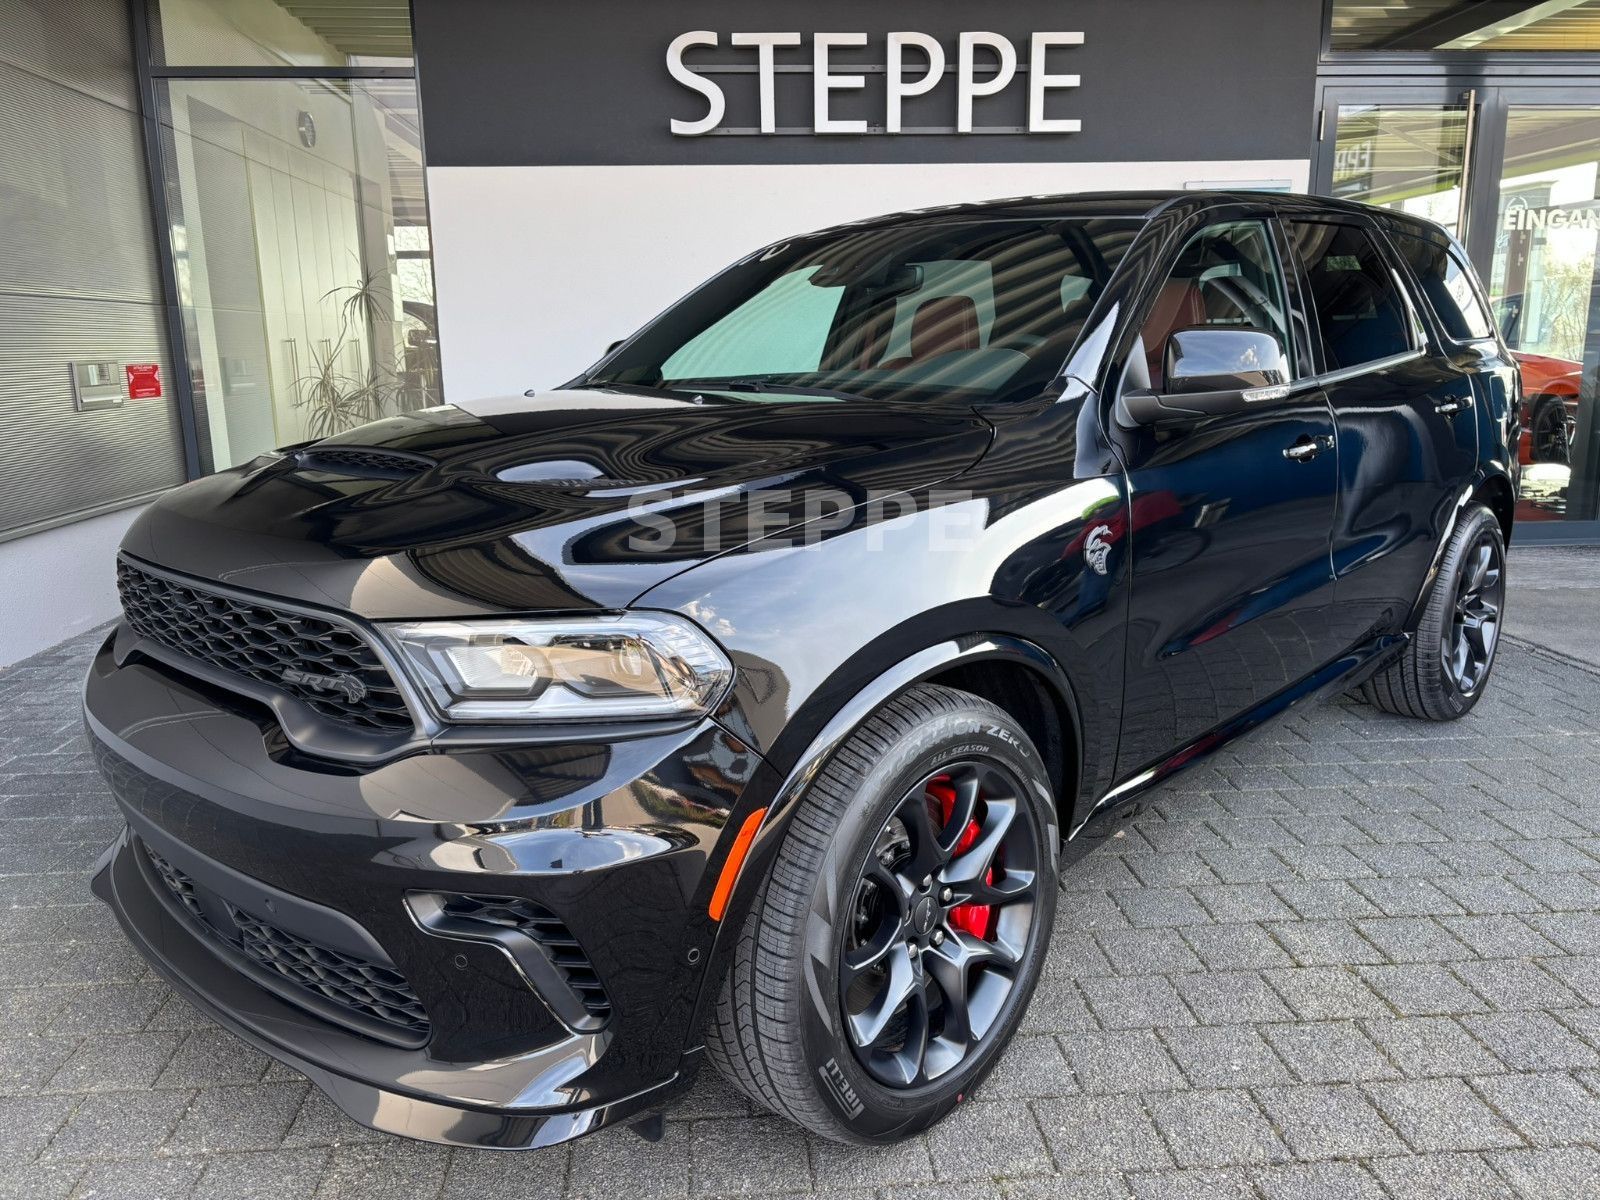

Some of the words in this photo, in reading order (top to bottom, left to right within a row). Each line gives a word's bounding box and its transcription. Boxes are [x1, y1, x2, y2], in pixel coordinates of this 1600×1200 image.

[666, 30, 1085, 136] STEPPE
[930, 751, 947, 766] ALL
[950, 744, 990, 756] SEASON
